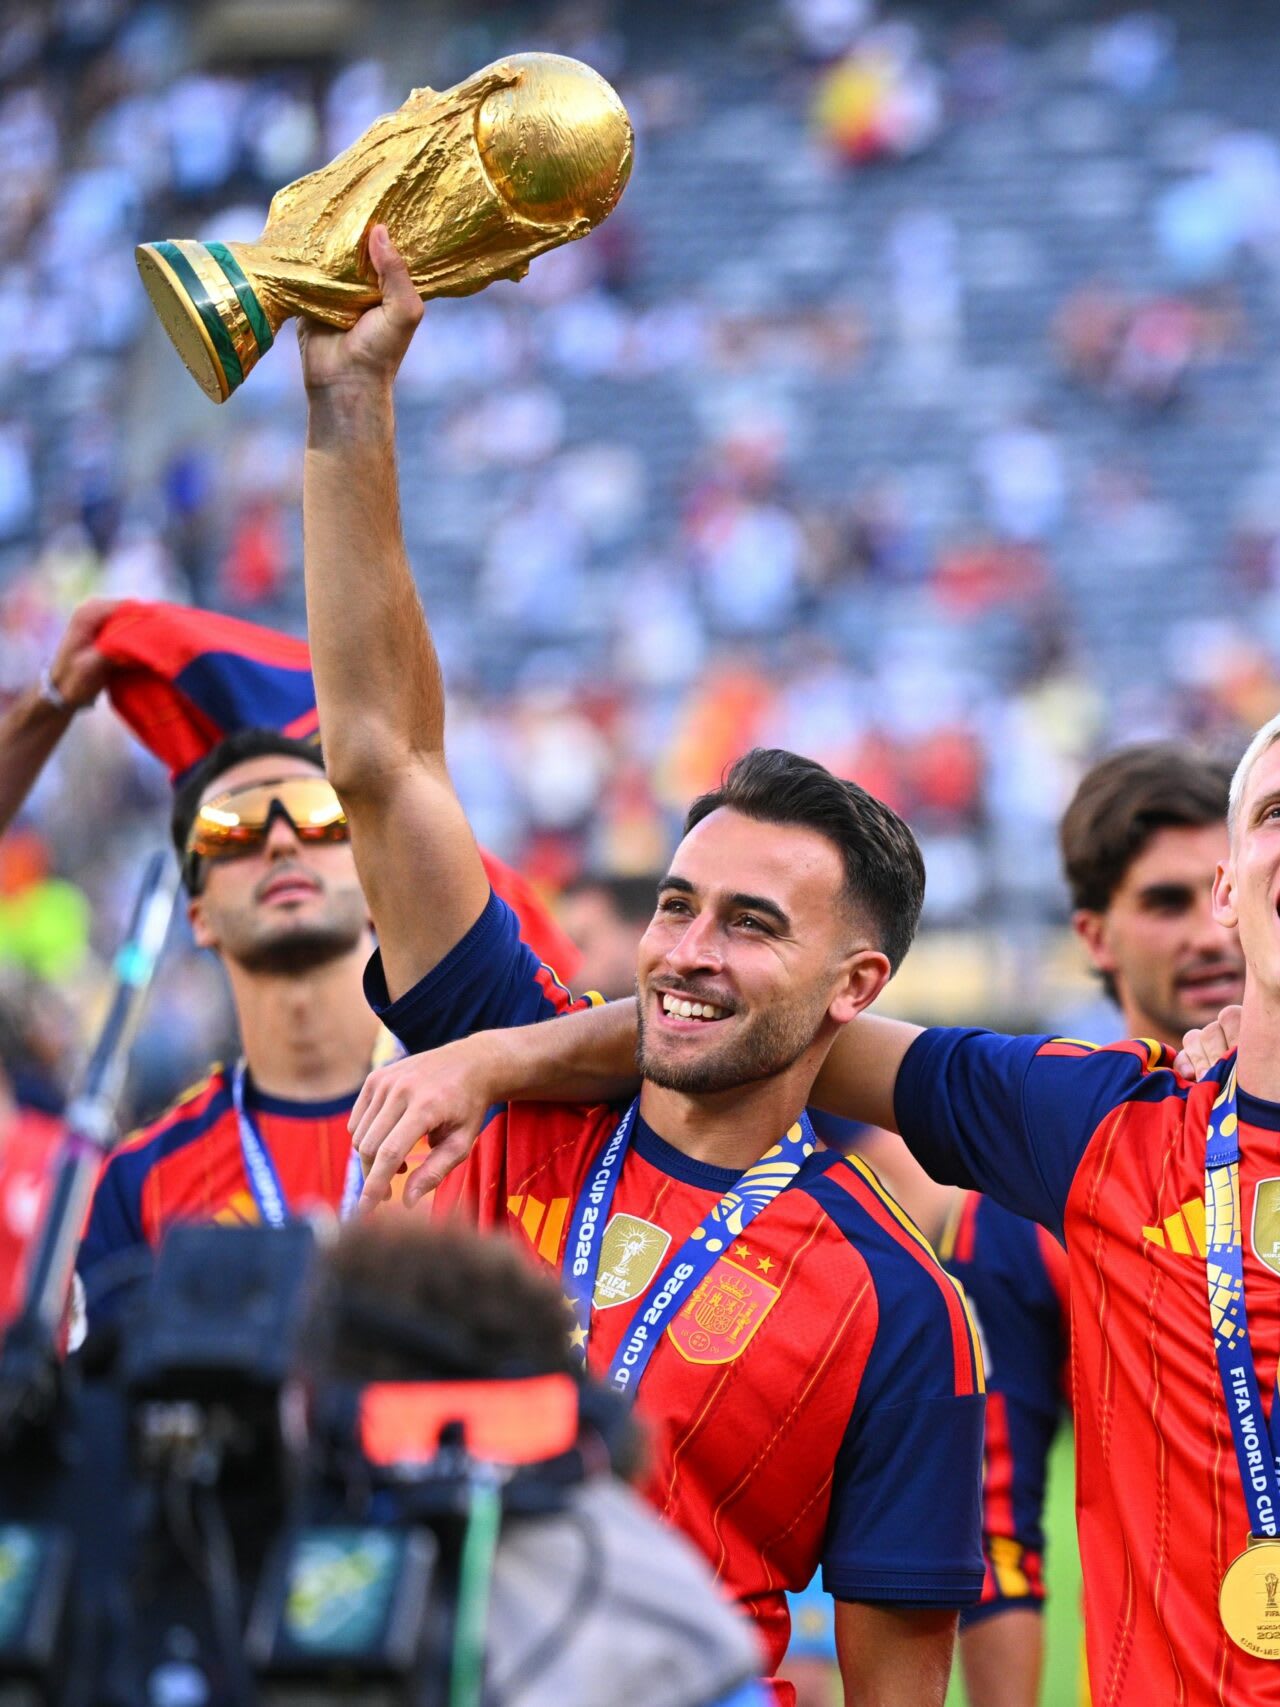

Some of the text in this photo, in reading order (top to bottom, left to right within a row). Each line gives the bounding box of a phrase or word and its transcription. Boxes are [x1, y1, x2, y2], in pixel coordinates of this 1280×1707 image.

[589, 1169, 611, 1204] CUP
[573, 1207, 599, 1277] 2026
[600, 1271, 627, 1292] FIFA
[623, 1262, 695, 1366] CUP 2026
[1230, 1366, 1277, 1537] FIFA WORLD CUP
